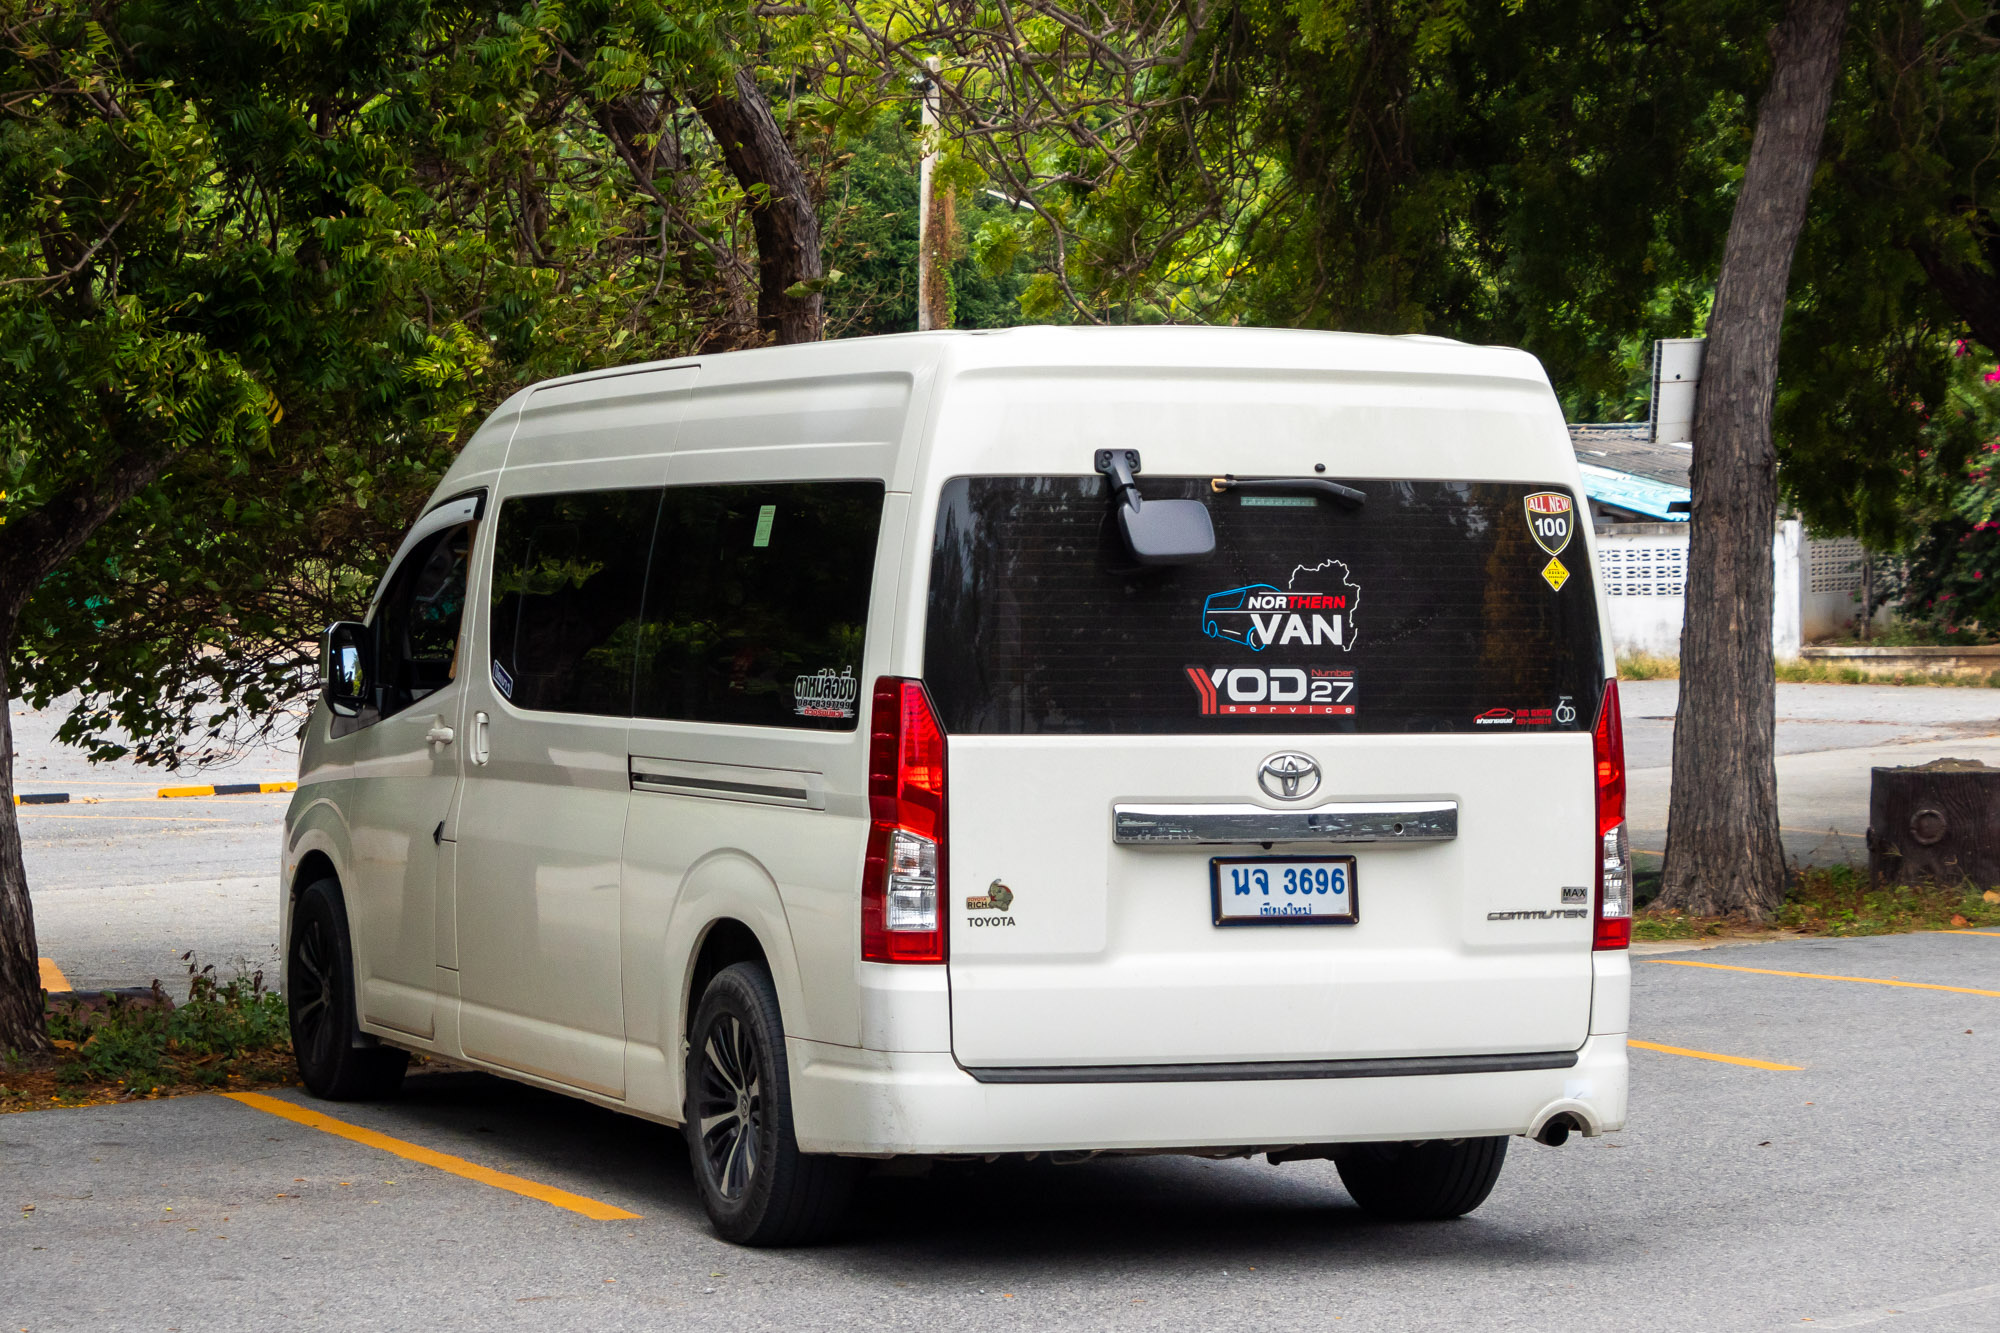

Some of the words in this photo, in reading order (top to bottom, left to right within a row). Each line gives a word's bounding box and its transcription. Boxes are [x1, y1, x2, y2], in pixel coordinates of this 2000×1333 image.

[1529, 497, 1547, 512] ALL
[1549, 496, 1569, 512] NEW
[1535, 518, 1567, 537] 100
[1248, 595, 1346, 609] NORTHERN
[1250, 614, 1343, 645] VAN
[1311, 669, 1354, 677] Number
[1186, 668, 1307, 715] YOD
[1311, 682, 1354, 702] 27
[1229, 706, 1353, 714] service
[1231, 868, 1270, 896] นจ
[1283, 868, 1345, 895] 3696
[1562, 888, 1586, 897] MAX
[967, 916, 1016, 927] TOYOTA
[1487, 909, 1588, 921] COMMUTER
